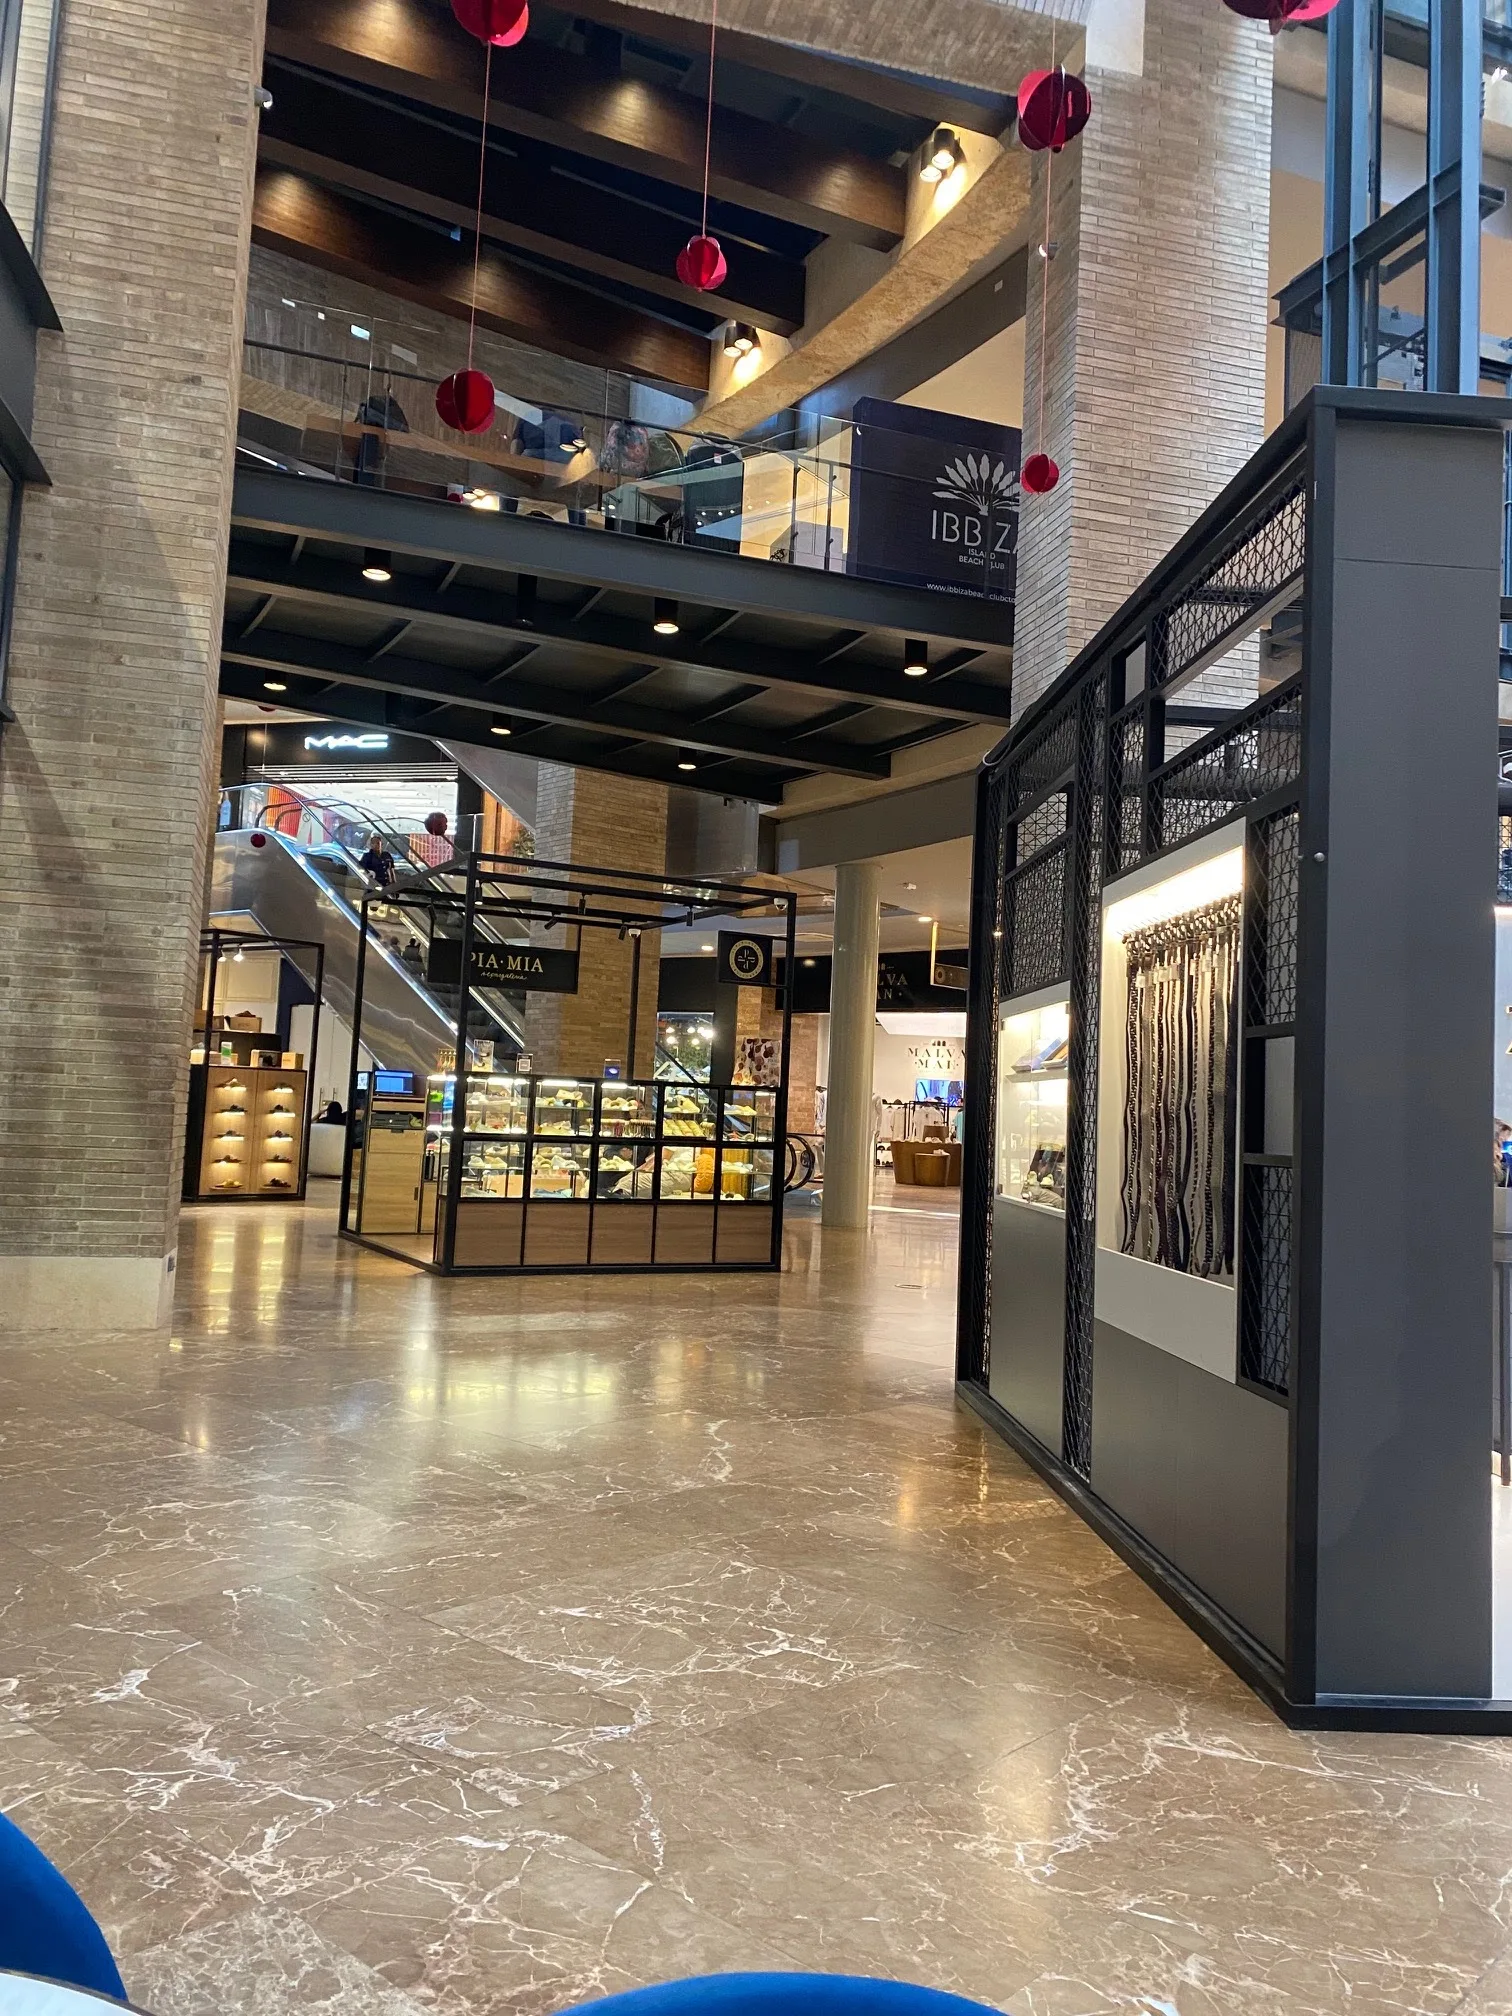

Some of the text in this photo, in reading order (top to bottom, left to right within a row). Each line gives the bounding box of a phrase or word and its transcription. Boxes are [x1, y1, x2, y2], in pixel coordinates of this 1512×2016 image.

[968, 548, 996, 560] ISLAD
[958, 555, 984, 566] BEACH
[304, 734, 389, 750] MAC
